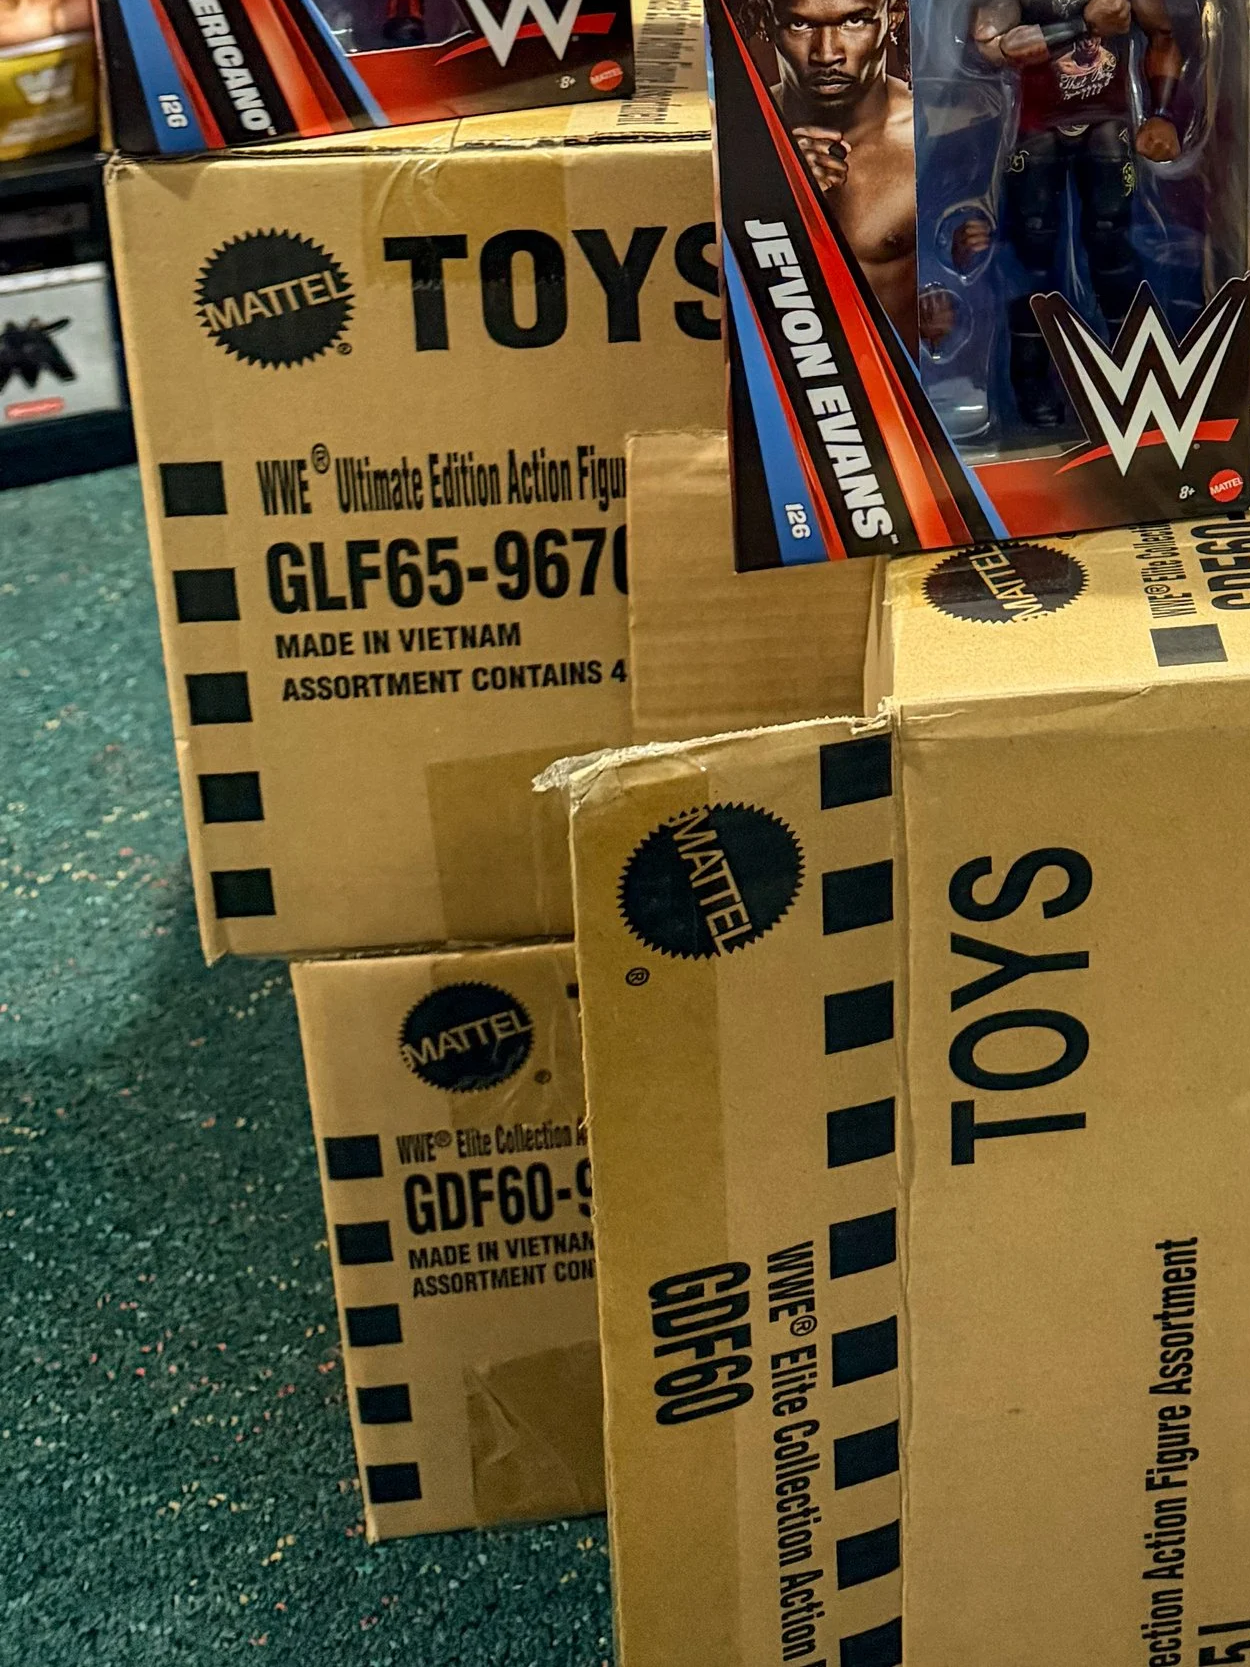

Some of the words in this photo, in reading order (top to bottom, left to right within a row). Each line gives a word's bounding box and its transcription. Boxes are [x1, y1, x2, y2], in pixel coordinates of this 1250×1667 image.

[201, 270, 353, 336] MATTEL
[743, 217, 839, 381] JE'VON
[806, 385, 894, 542] EVANS
[335, 453, 424, 515] Ultimate
[428, 449, 502, 509] Edition
[507, 447, 573, 507] Action
[1178, 484, 1196, 500] 8+
[1209, 477, 1243, 495] MATTEL
[784, 503, 811, 540] 126
[1141, 560, 1187, 583] Elite
[275, 631, 356, 660] MADE
[364, 631, 391, 656] IN
[398, 622, 522, 653] VIETNAM
[281, 669, 462, 703] ASSORTMENT
[470, 661, 603, 693] CONTAINS
[610, 660, 628, 685] 4
[666, 804, 755, 957] MATTEL
[402, 1008, 532, 1070] MATTEL
[948, 846, 1094, 1166] TOYS
[456, 1126, 492, 1160] Elite
[495, 1120, 570, 1156] Collection
[408, 1246, 472, 1270] MADE
[477, 1242, 501, 1264] IN
[412, 1266, 550, 1298] ASSORTMENT
[648, 1261, 754, 1426] GDF60
[1148, 1236, 1198, 1396] Assortment
[770, 1343, 818, 1418] Elite
[1144, 1404, 1200, 1493] Figure
[773, 1418, 822, 1568] Collection
[1141, 1496, 1187, 1581] Action
[779, 1568, 825, 1663] Action
